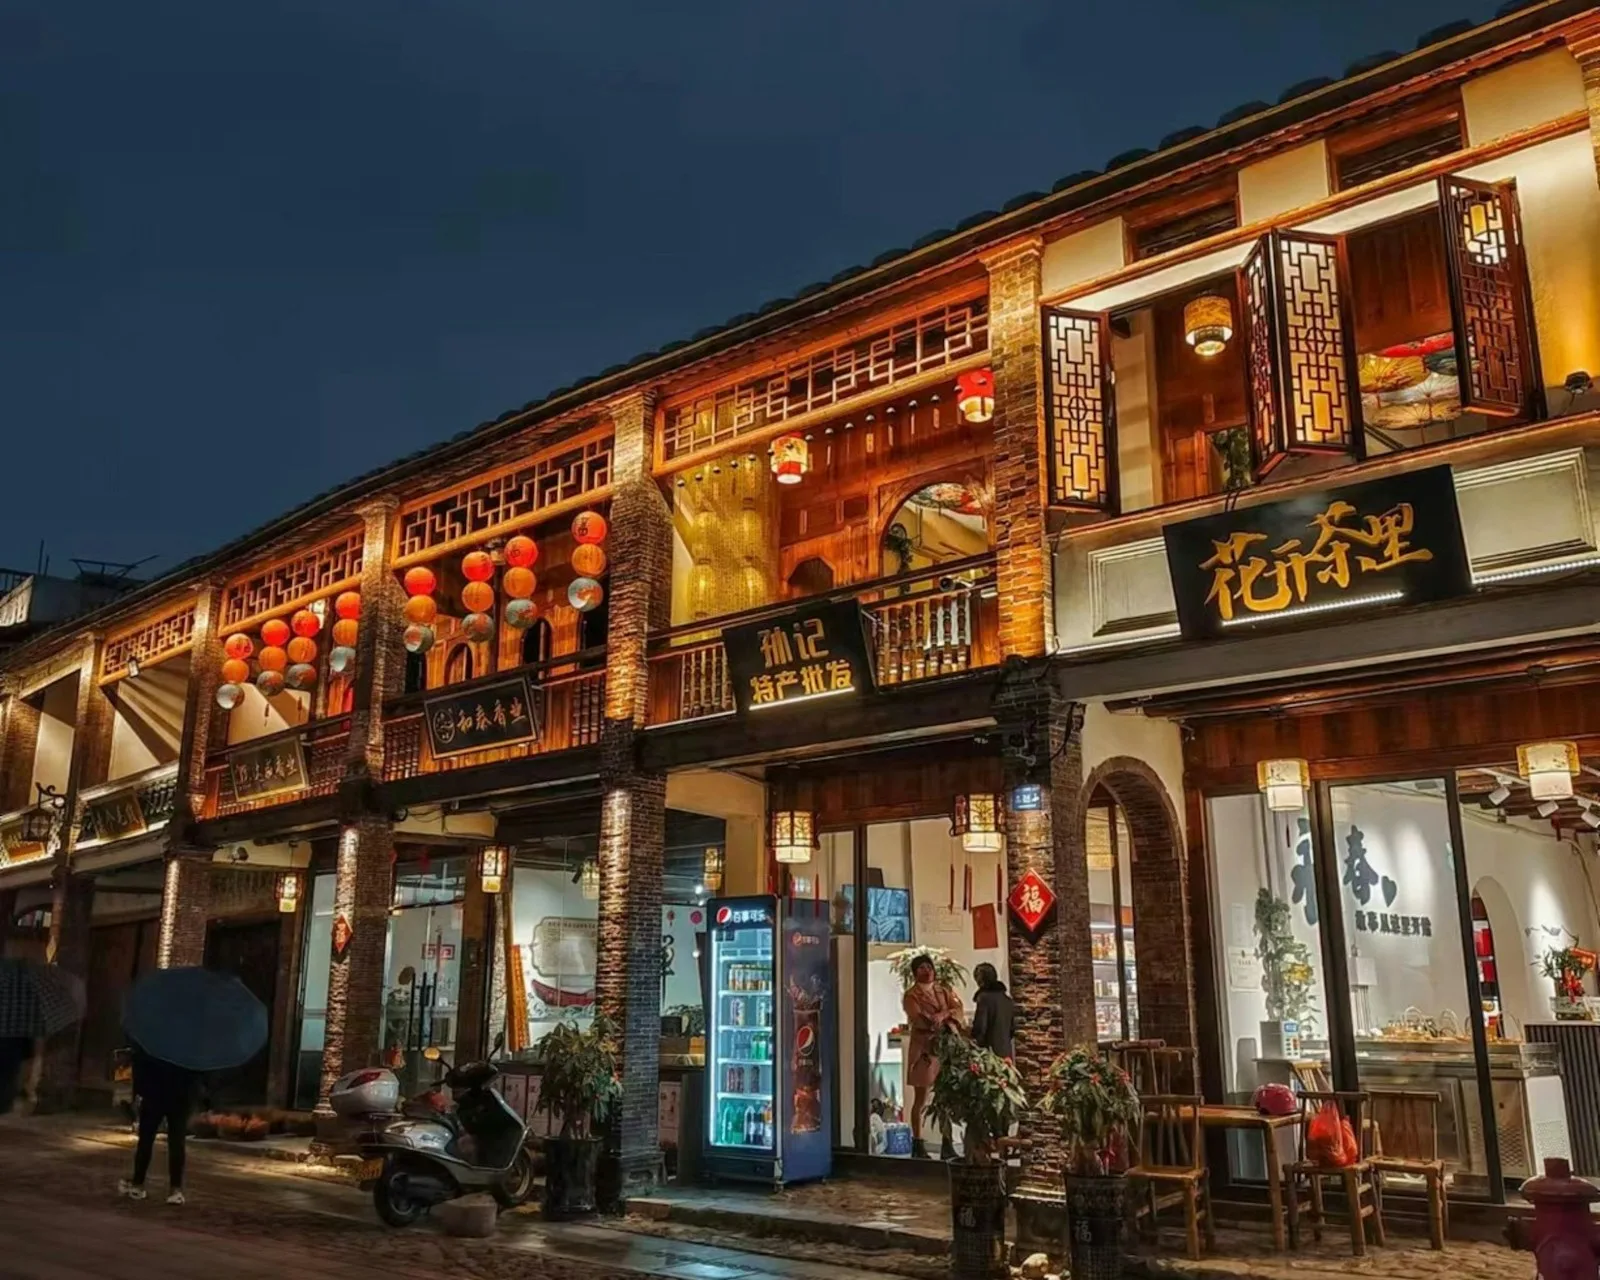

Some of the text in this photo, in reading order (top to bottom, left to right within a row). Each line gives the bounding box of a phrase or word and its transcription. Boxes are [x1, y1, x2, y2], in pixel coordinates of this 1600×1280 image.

[757, 618, 829, 668] 孙记
[750, 659, 852, 703] 特产批发
[733, 909, 766, 923] 百事可乐
[1016, 884, 1046, 914] 福
